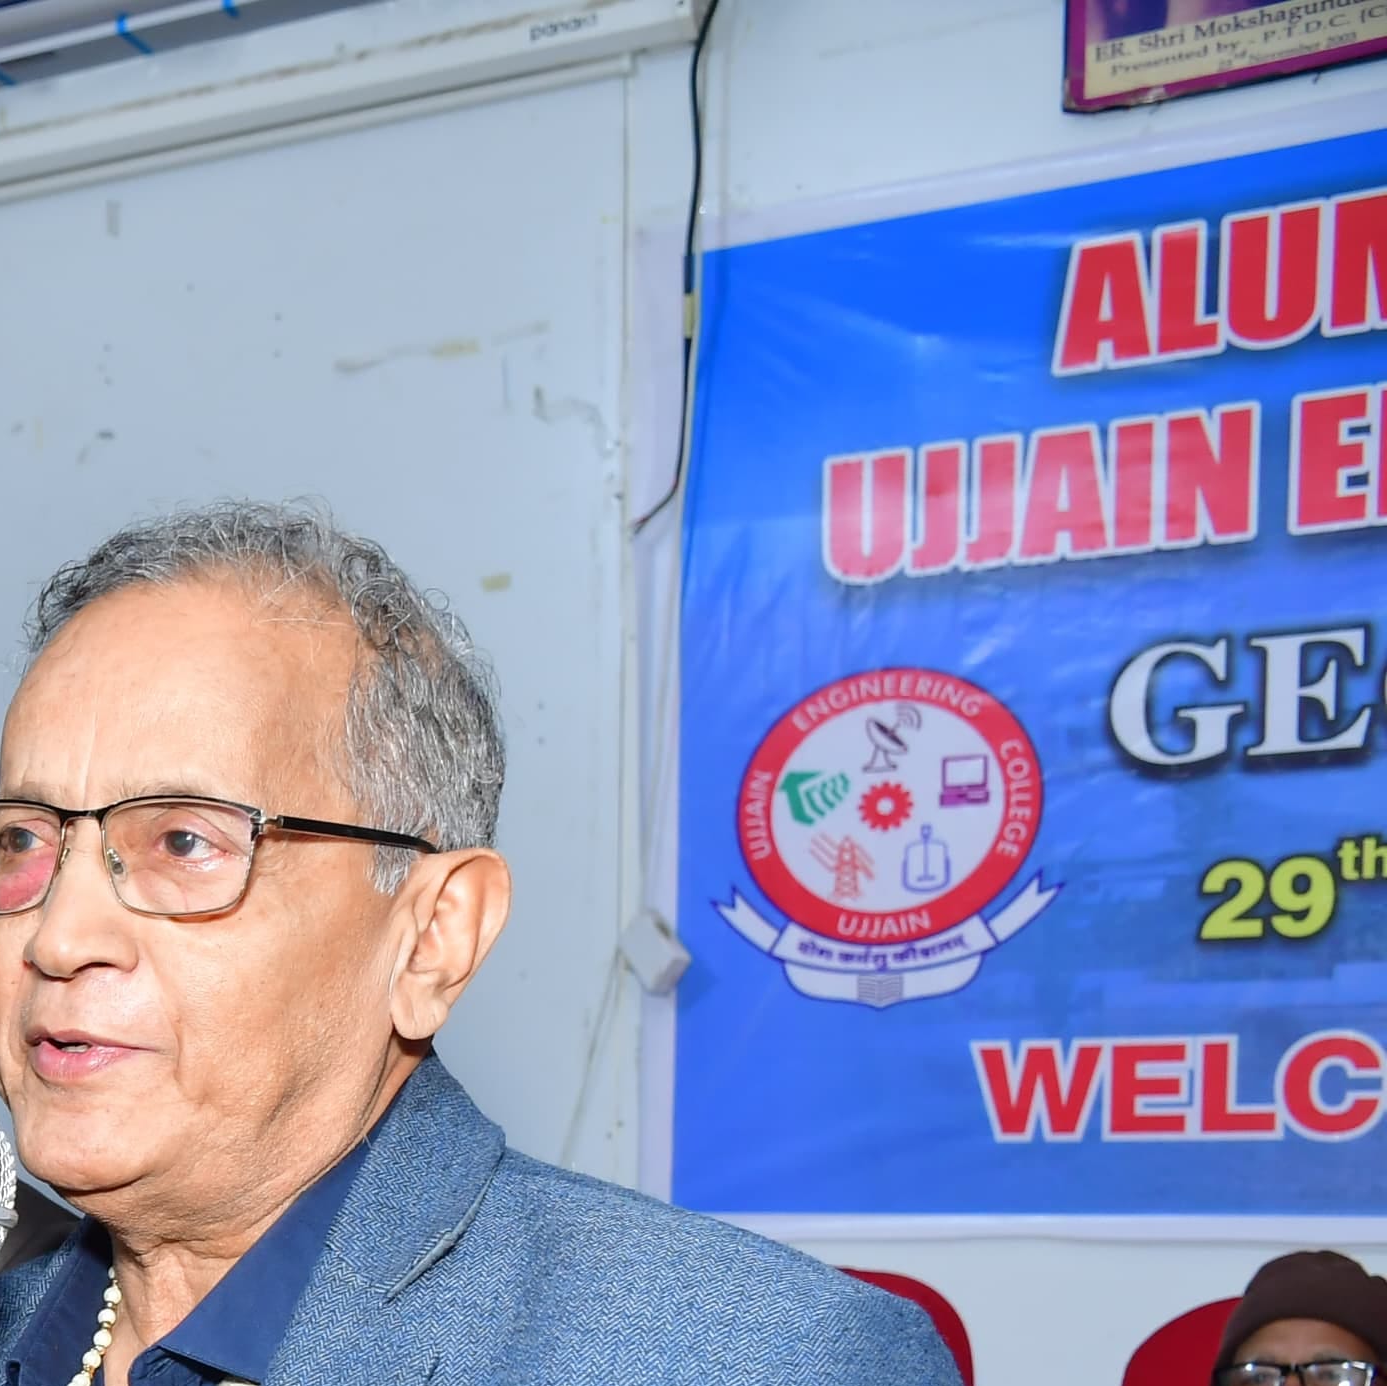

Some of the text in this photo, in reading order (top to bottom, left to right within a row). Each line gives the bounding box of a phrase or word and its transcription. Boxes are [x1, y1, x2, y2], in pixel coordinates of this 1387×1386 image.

[1139, 30, 1185, 52] Shri
[1193, 0, 1366, 41] Mokshagun
[822, 380, 1387, 585] UJJAIN E
[1109, 627, 1387, 766] GE
[744, 673, 1033, 860] UJJAIN ENGINEERING COLLEGE
[836, 910, 932, 938] UJJAIN
[1200, 836, 1387, 940] 29th
[969, 1030, 1386, 1143] WELC
